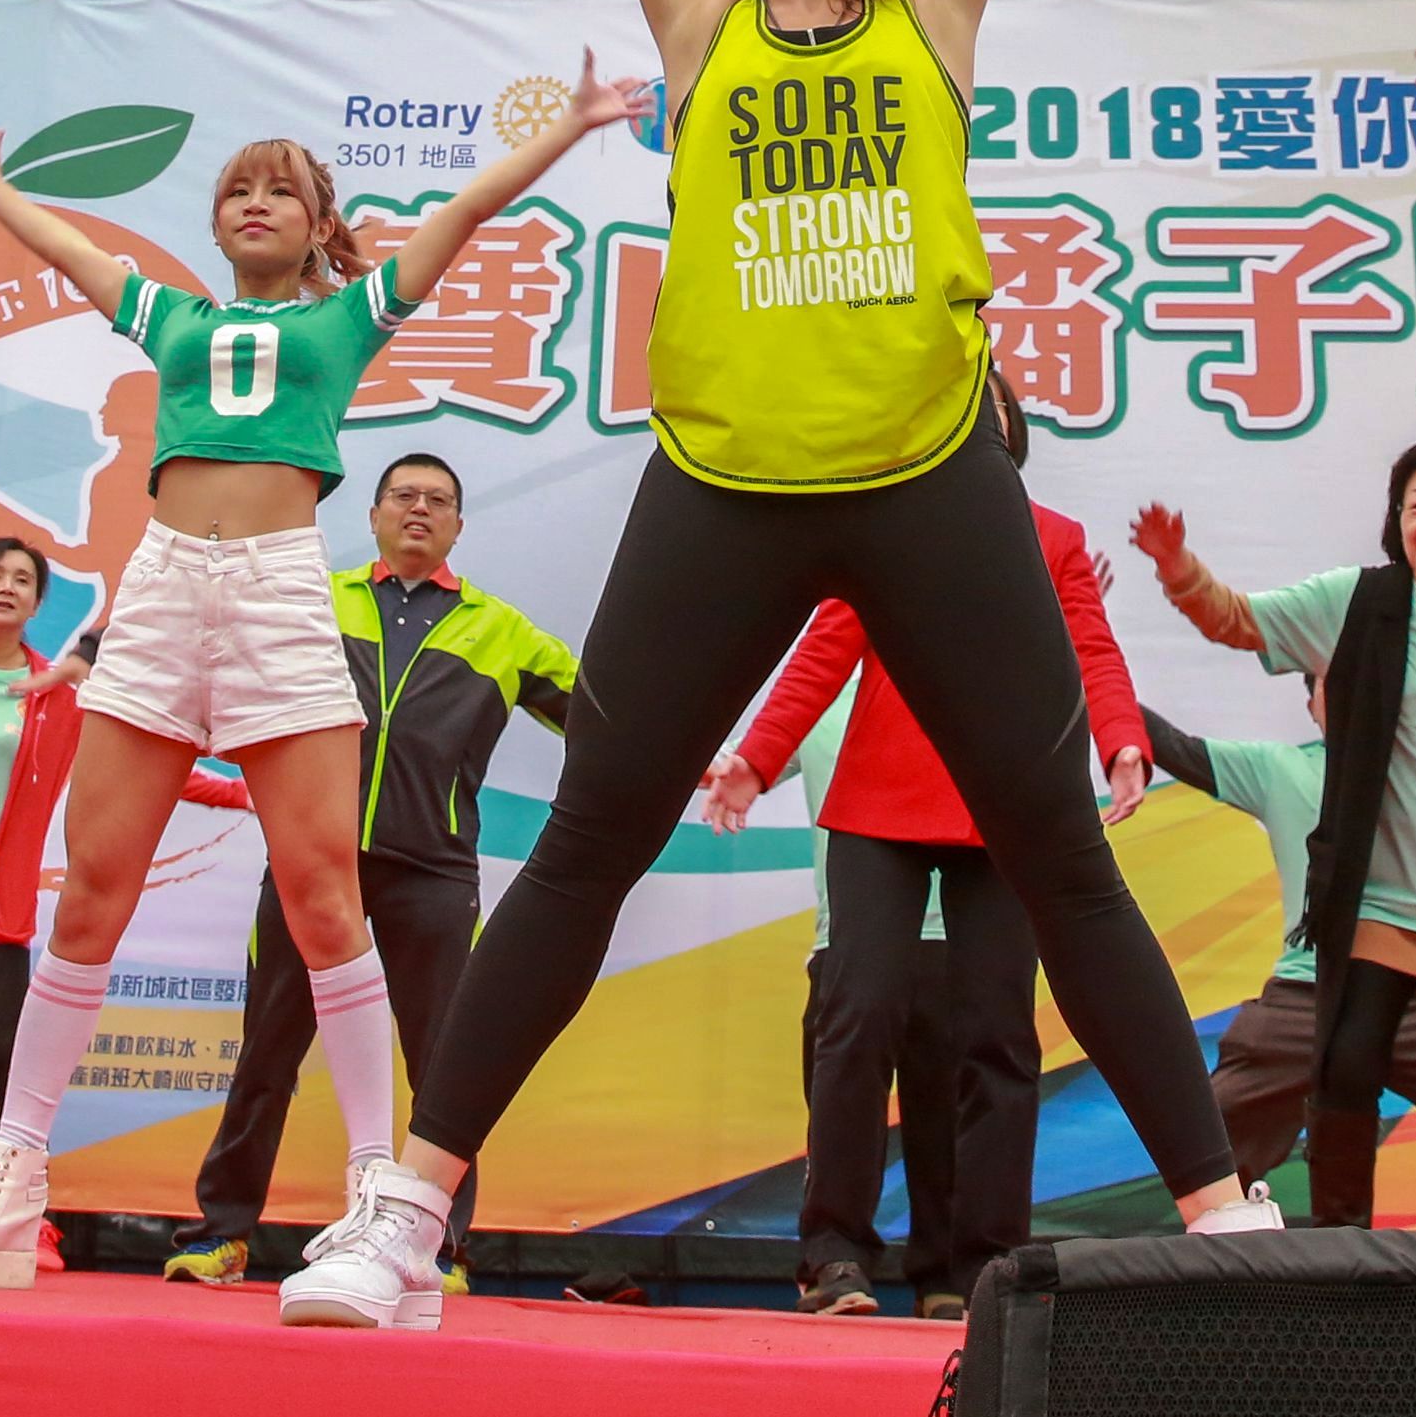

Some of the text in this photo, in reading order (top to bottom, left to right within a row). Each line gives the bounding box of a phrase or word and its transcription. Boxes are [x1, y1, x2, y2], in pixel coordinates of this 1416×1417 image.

[344, 95, 482, 135] Rotary
[729, 75, 906, 144] SORE
[336, 143, 477, 169] 3501 地區
[730, 135, 906, 200] TODAY
[733, 189, 911, 258] STRONG
[734, 244, 915, 311] TOMORROW
[847, 295, 915, 310] TOUCH AERO
[210, 322, 280, 416] 0
